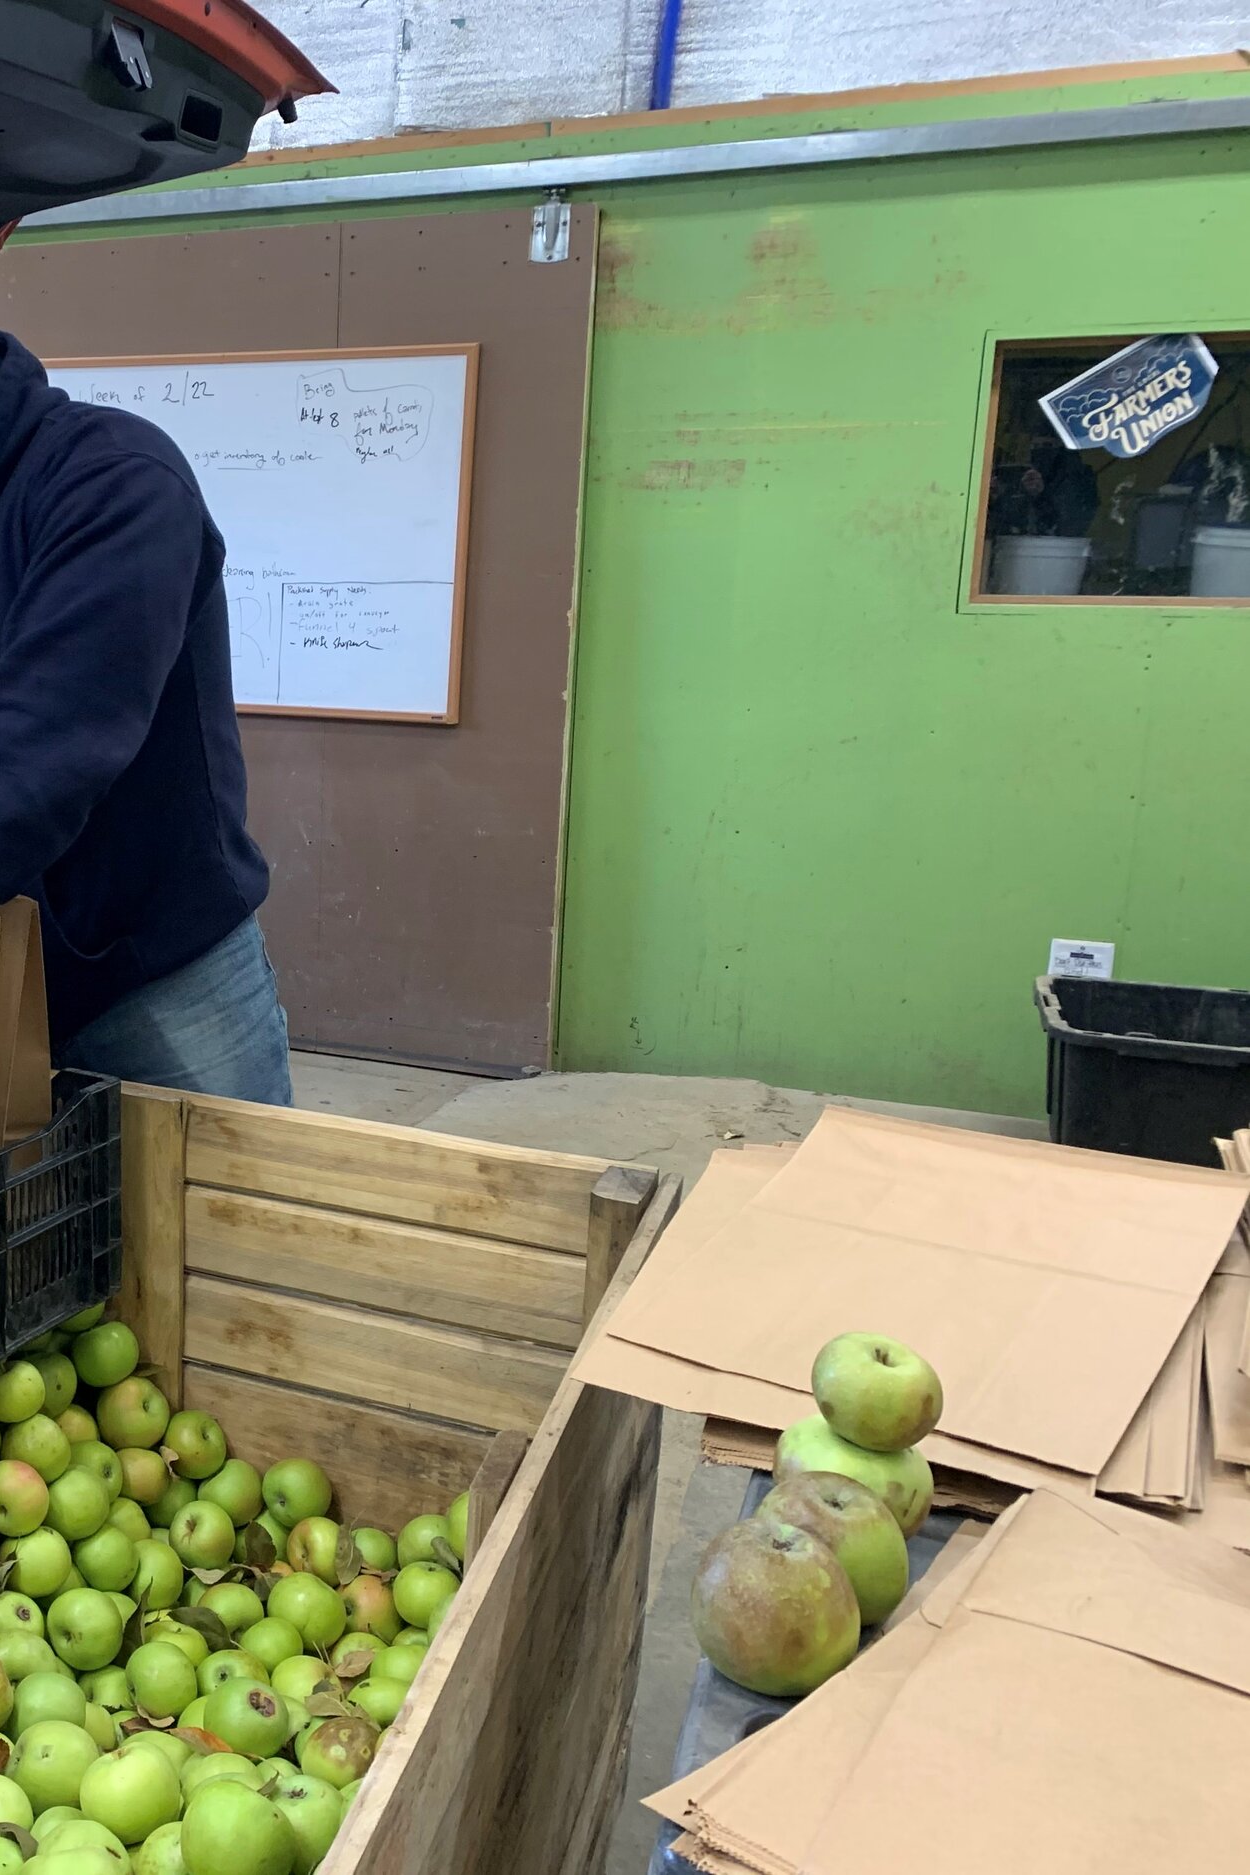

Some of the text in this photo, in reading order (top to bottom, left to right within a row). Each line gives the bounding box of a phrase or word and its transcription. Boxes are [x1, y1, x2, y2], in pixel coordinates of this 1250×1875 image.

[133, 385, 146, 402] of
[161, 370, 215, 406] 2/22
[1082, 360, 1192, 442] FARMERS
[329, 412, 339, 428] 8
[379, 418, 418, 444] Monday
[1110, 389, 1194, 454] UNION
